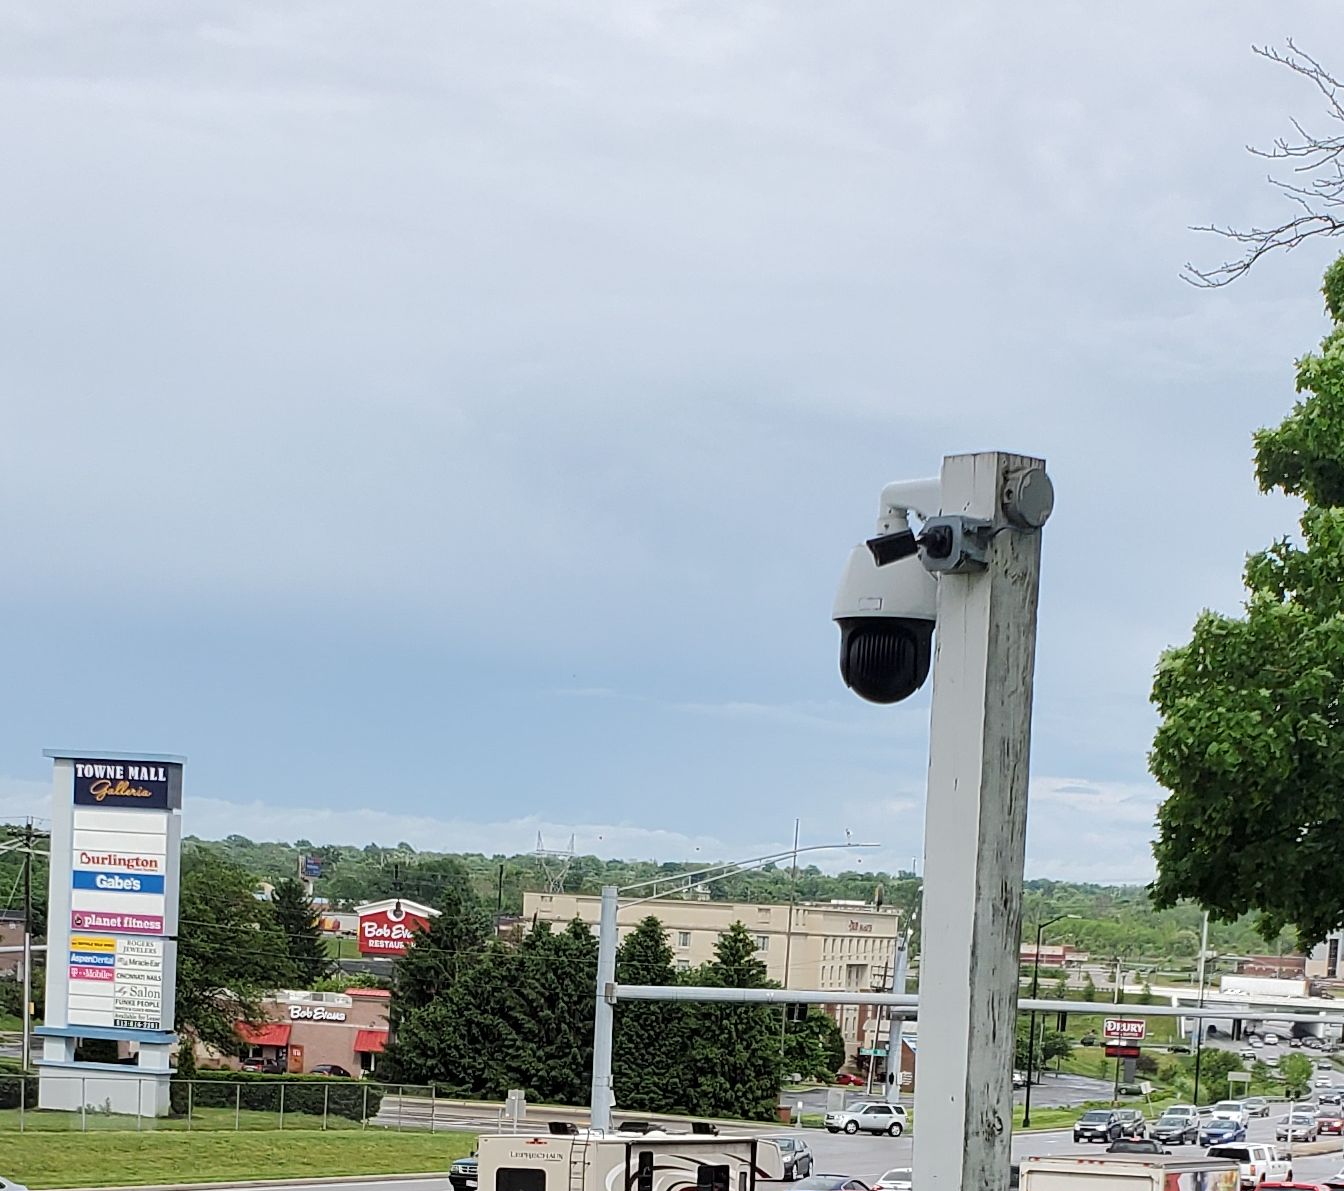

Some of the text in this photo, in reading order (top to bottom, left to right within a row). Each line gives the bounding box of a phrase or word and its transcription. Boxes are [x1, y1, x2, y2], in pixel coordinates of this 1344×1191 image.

[76, 763, 166, 782] TOWNE MALL
[90, 780, 152, 801] Galleria
[80, 852, 158, 869] Burlington
[96, 874, 141, 891] Gabe's
[84, 914, 162, 930] planet fitness
[362, 921, 390, 938] Bob
[123, 946, 157, 954] JEWELERS
[129, 958, 161, 967] Miracle-Ear
[130, 985, 161, 999] Salon
[137, 1000, 160, 1008] PEOPLE
[288, 1006, 346, 1021] Bob Evans
[510, 1151, 563, 1160] LEPRECHAUN
